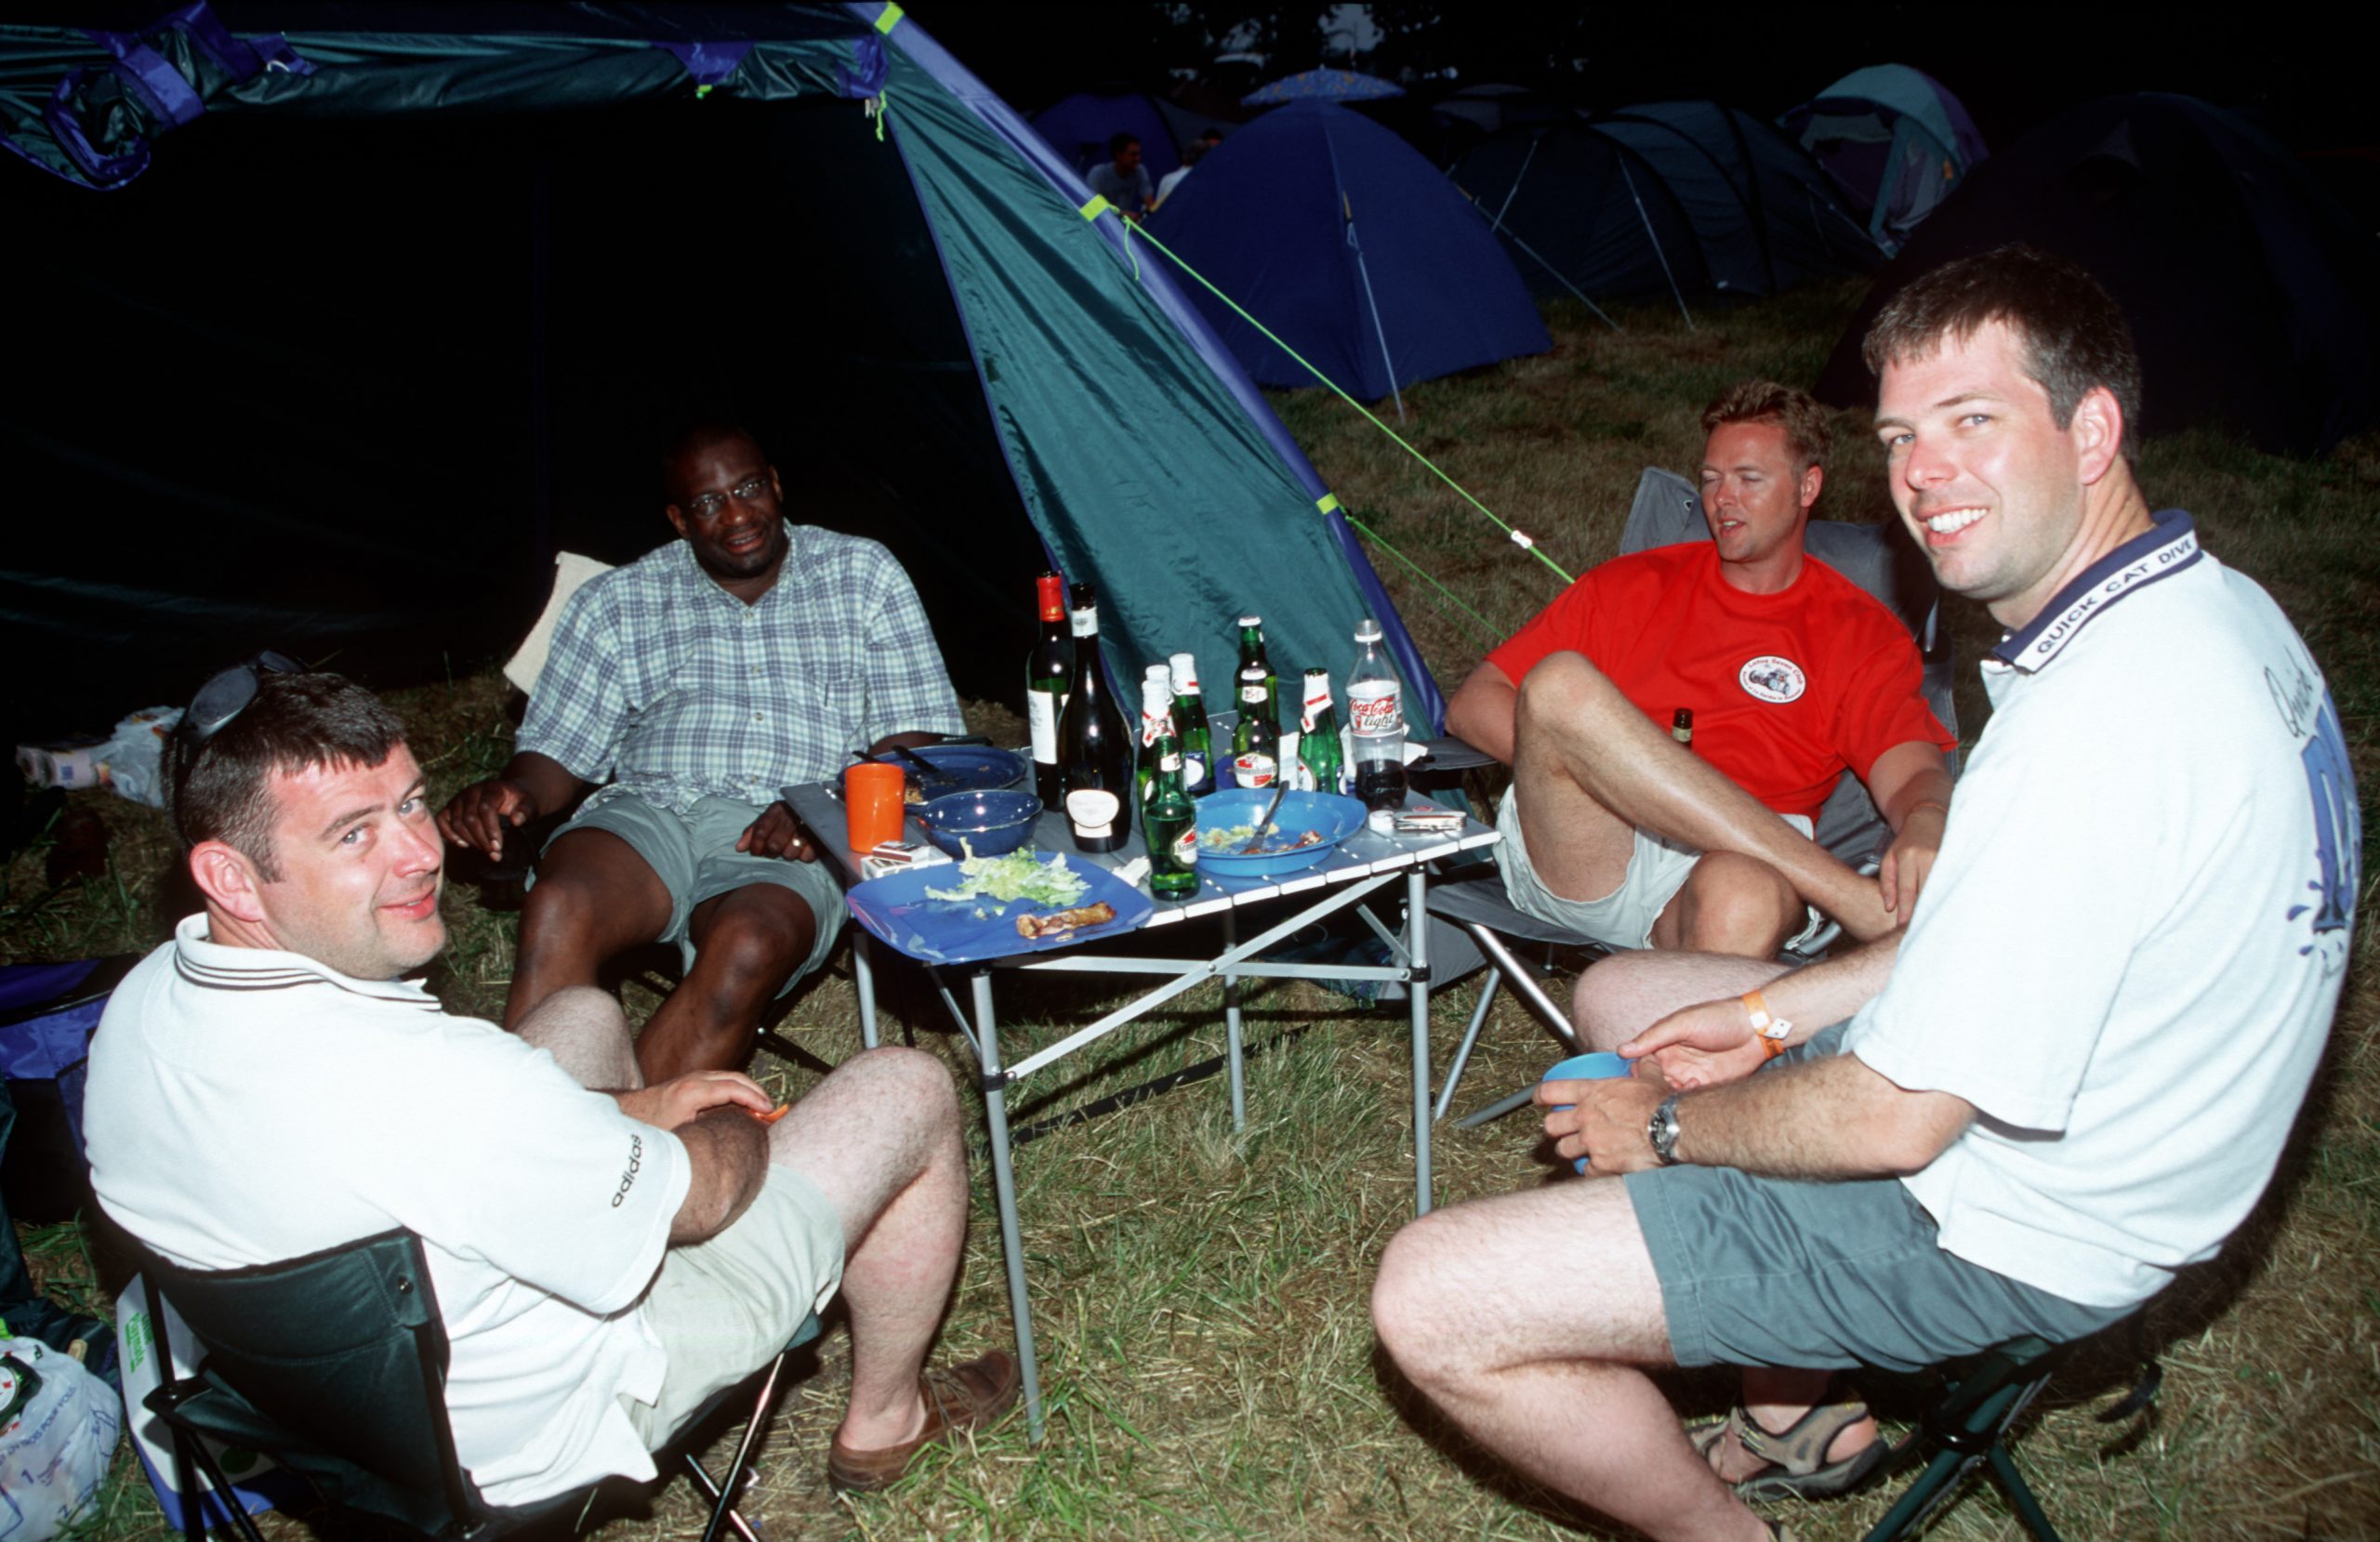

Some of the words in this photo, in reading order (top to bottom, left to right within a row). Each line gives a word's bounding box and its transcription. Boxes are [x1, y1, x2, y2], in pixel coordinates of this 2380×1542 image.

[2037, 598, 2098, 653] QUICK
[2105, 562, 2149, 593] CAT
[1364, 714, 1394, 731] light
[612, 1134, 641, 1208] adidas
